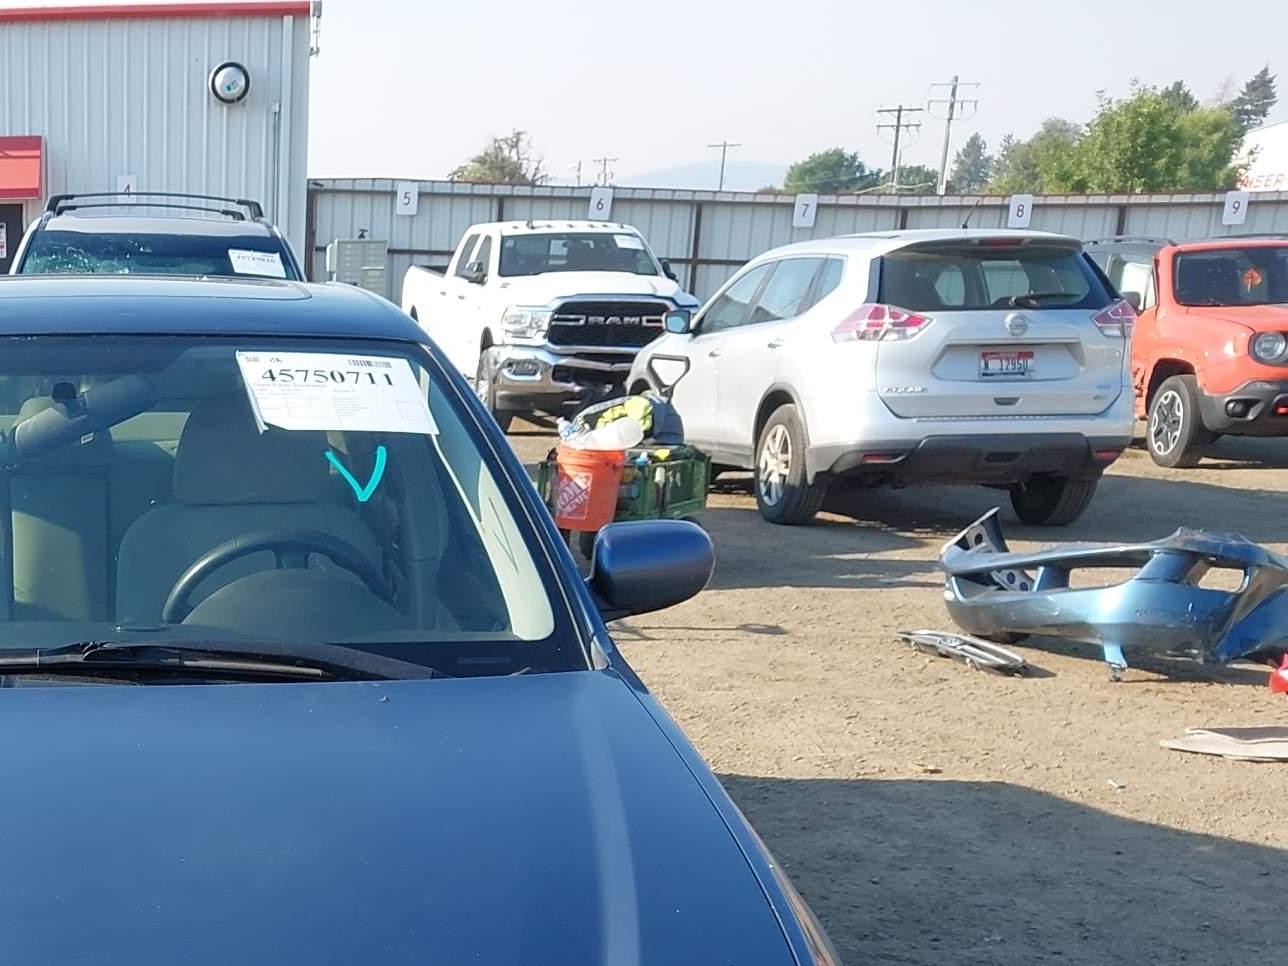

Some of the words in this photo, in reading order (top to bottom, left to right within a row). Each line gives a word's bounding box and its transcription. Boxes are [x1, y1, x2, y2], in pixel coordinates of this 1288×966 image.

[403, 191, 411, 206] 5
[595, 197, 605, 211] 6
[800, 203, 810, 218] 7
[1016, 204, 1025, 218] 8
[1232, 200, 1241, 215] 9
[587, 315, 640, 326] RAM
[261, 368, 395, 386] 45750711
